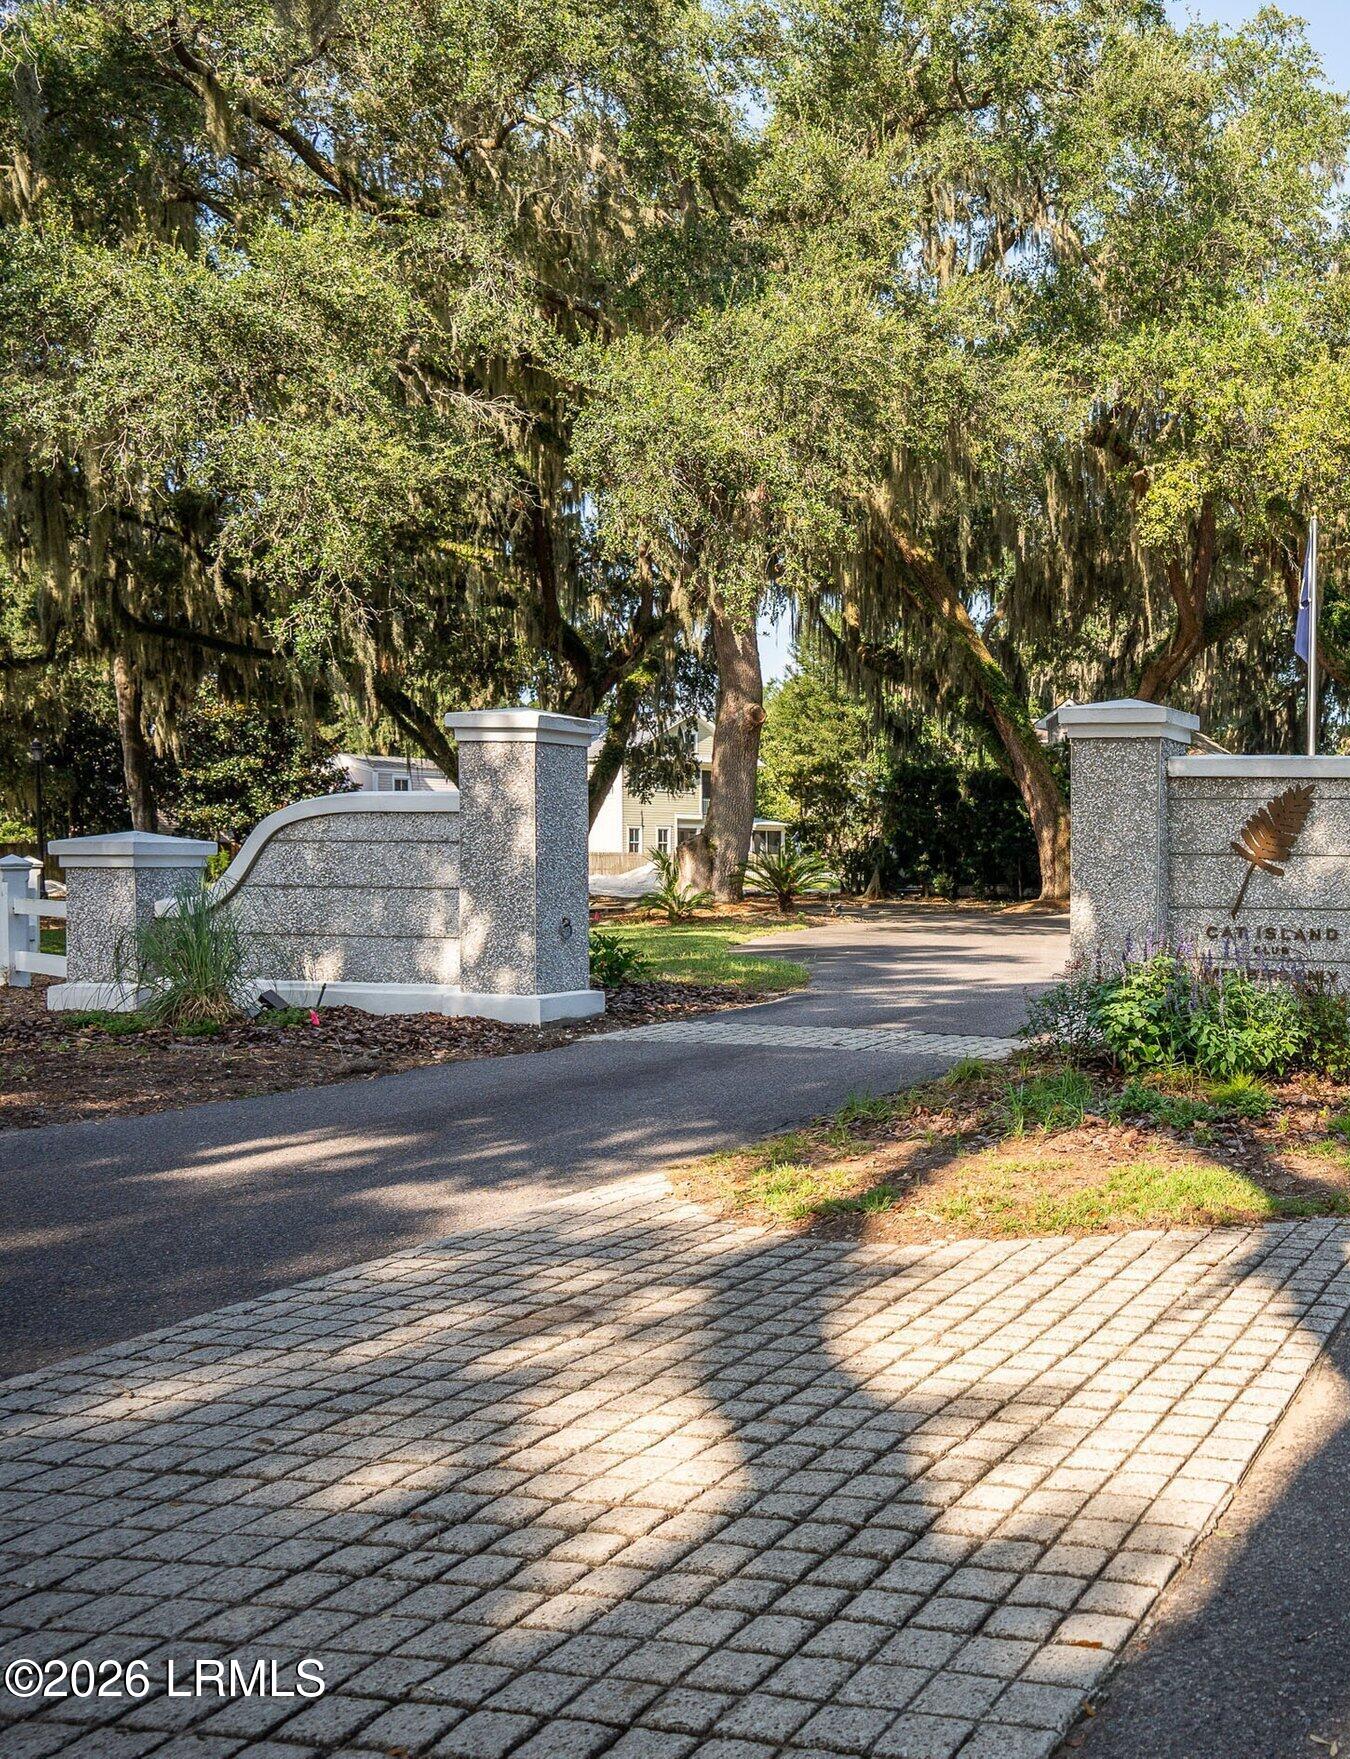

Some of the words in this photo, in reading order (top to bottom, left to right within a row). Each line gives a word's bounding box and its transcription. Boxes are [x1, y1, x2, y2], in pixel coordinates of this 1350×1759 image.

[1206, 926, 1248, 940] CAT
[1256, 926, 1339, 941] ISLAND
[1253, 945, 1289, 955] CLUB
